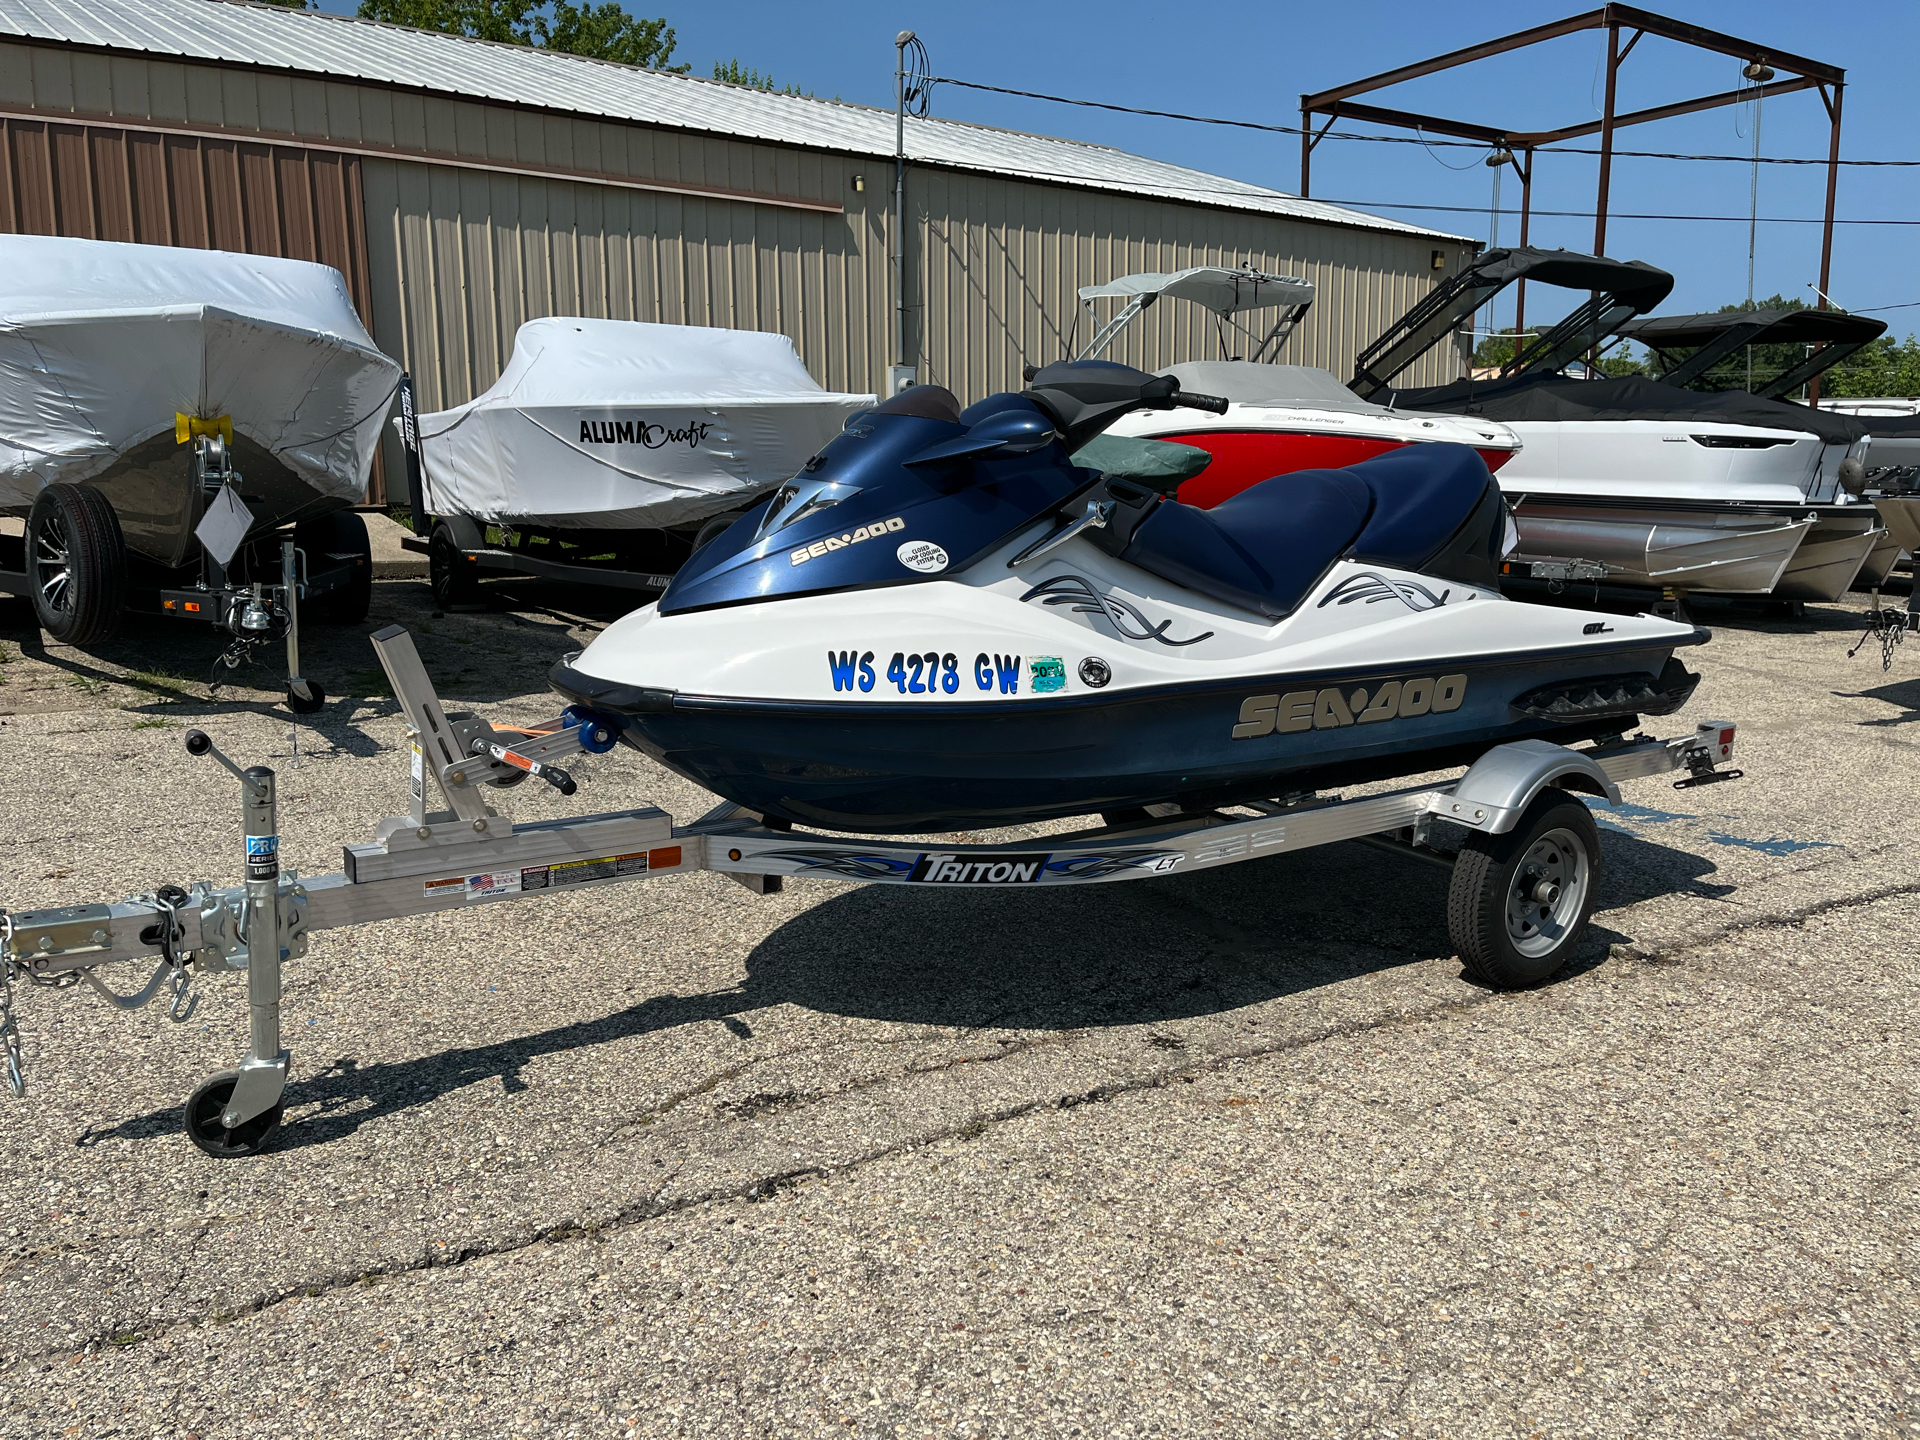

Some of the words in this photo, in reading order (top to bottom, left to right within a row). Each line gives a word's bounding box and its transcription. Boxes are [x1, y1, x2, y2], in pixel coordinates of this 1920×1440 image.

[1288, 416, 1345, 425] CHALLENGER
[905, 555, 918, 563] LOOP
[919, 548, 940, 558] COOLING
[912, 545, 930, 554] CLOSED
[916, 556, 935, 565] SYSTEM
[646, 576, 671, 588] ALUM
[1582, 621, 1606, 636] GTX
[828, 650, 876, 693] WS
[886, 651, 960, 694] 4278
[974, 652, 1021, 694] GW
[250, 855, 274, 863] SERIE
[1155, 857, 1183, 870] LT
[254, 867, 270, 875] 1,000
[923, 854, 1038, 882] TRITON
